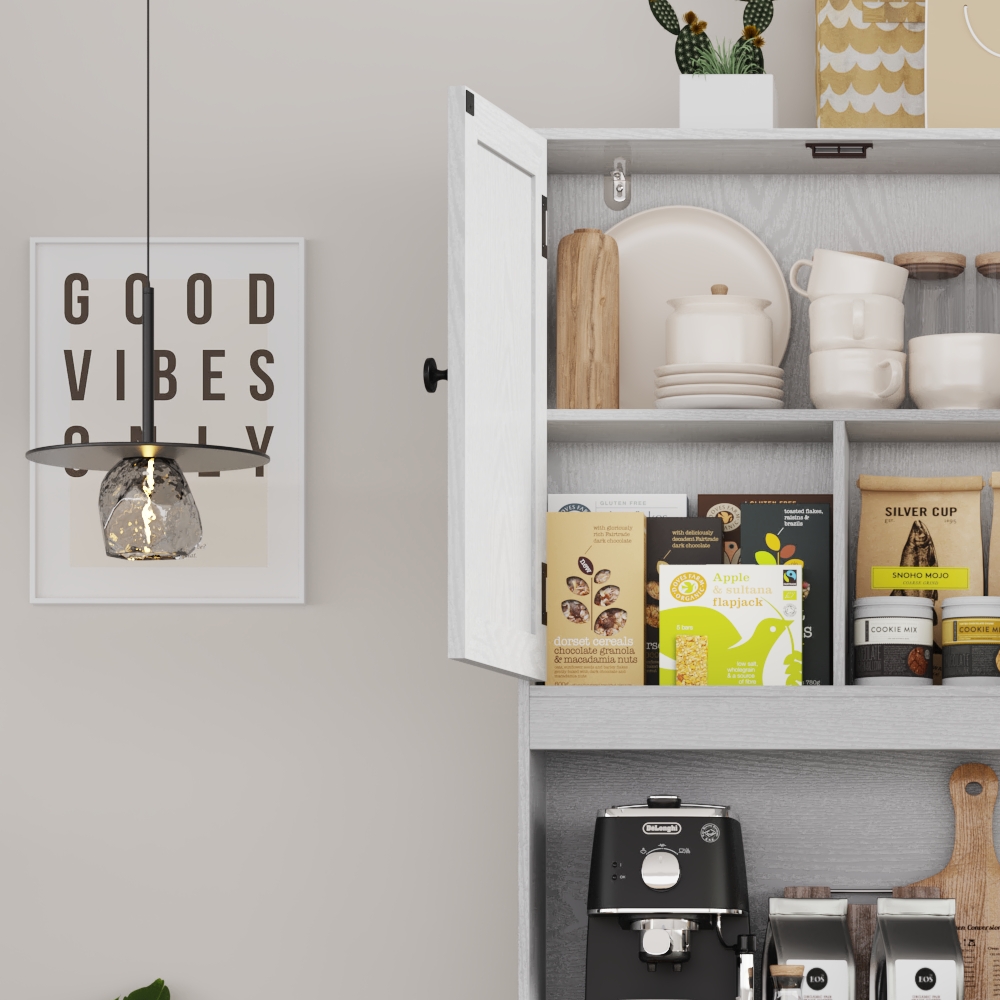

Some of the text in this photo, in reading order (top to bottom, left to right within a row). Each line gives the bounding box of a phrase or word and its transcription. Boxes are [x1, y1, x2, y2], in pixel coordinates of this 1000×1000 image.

[64, 273, 274, 324] GOOD
[64, 350, 274, 401] VIBES
[886, 507, 957, 517] SILVER CUP
[580, 558, 592, 573] new
[672, 574, 705, 592] DOVES FARM
[713, 573, 750, 584] Apple
[676, 586, 706, 602] ORGANIC
[713, 586, 772, 594] & sultana
[713, 598, 763, 608] flapjack
[554, 636, 634, 646] dorset cereals
[600, 647, 635, 656] granola
